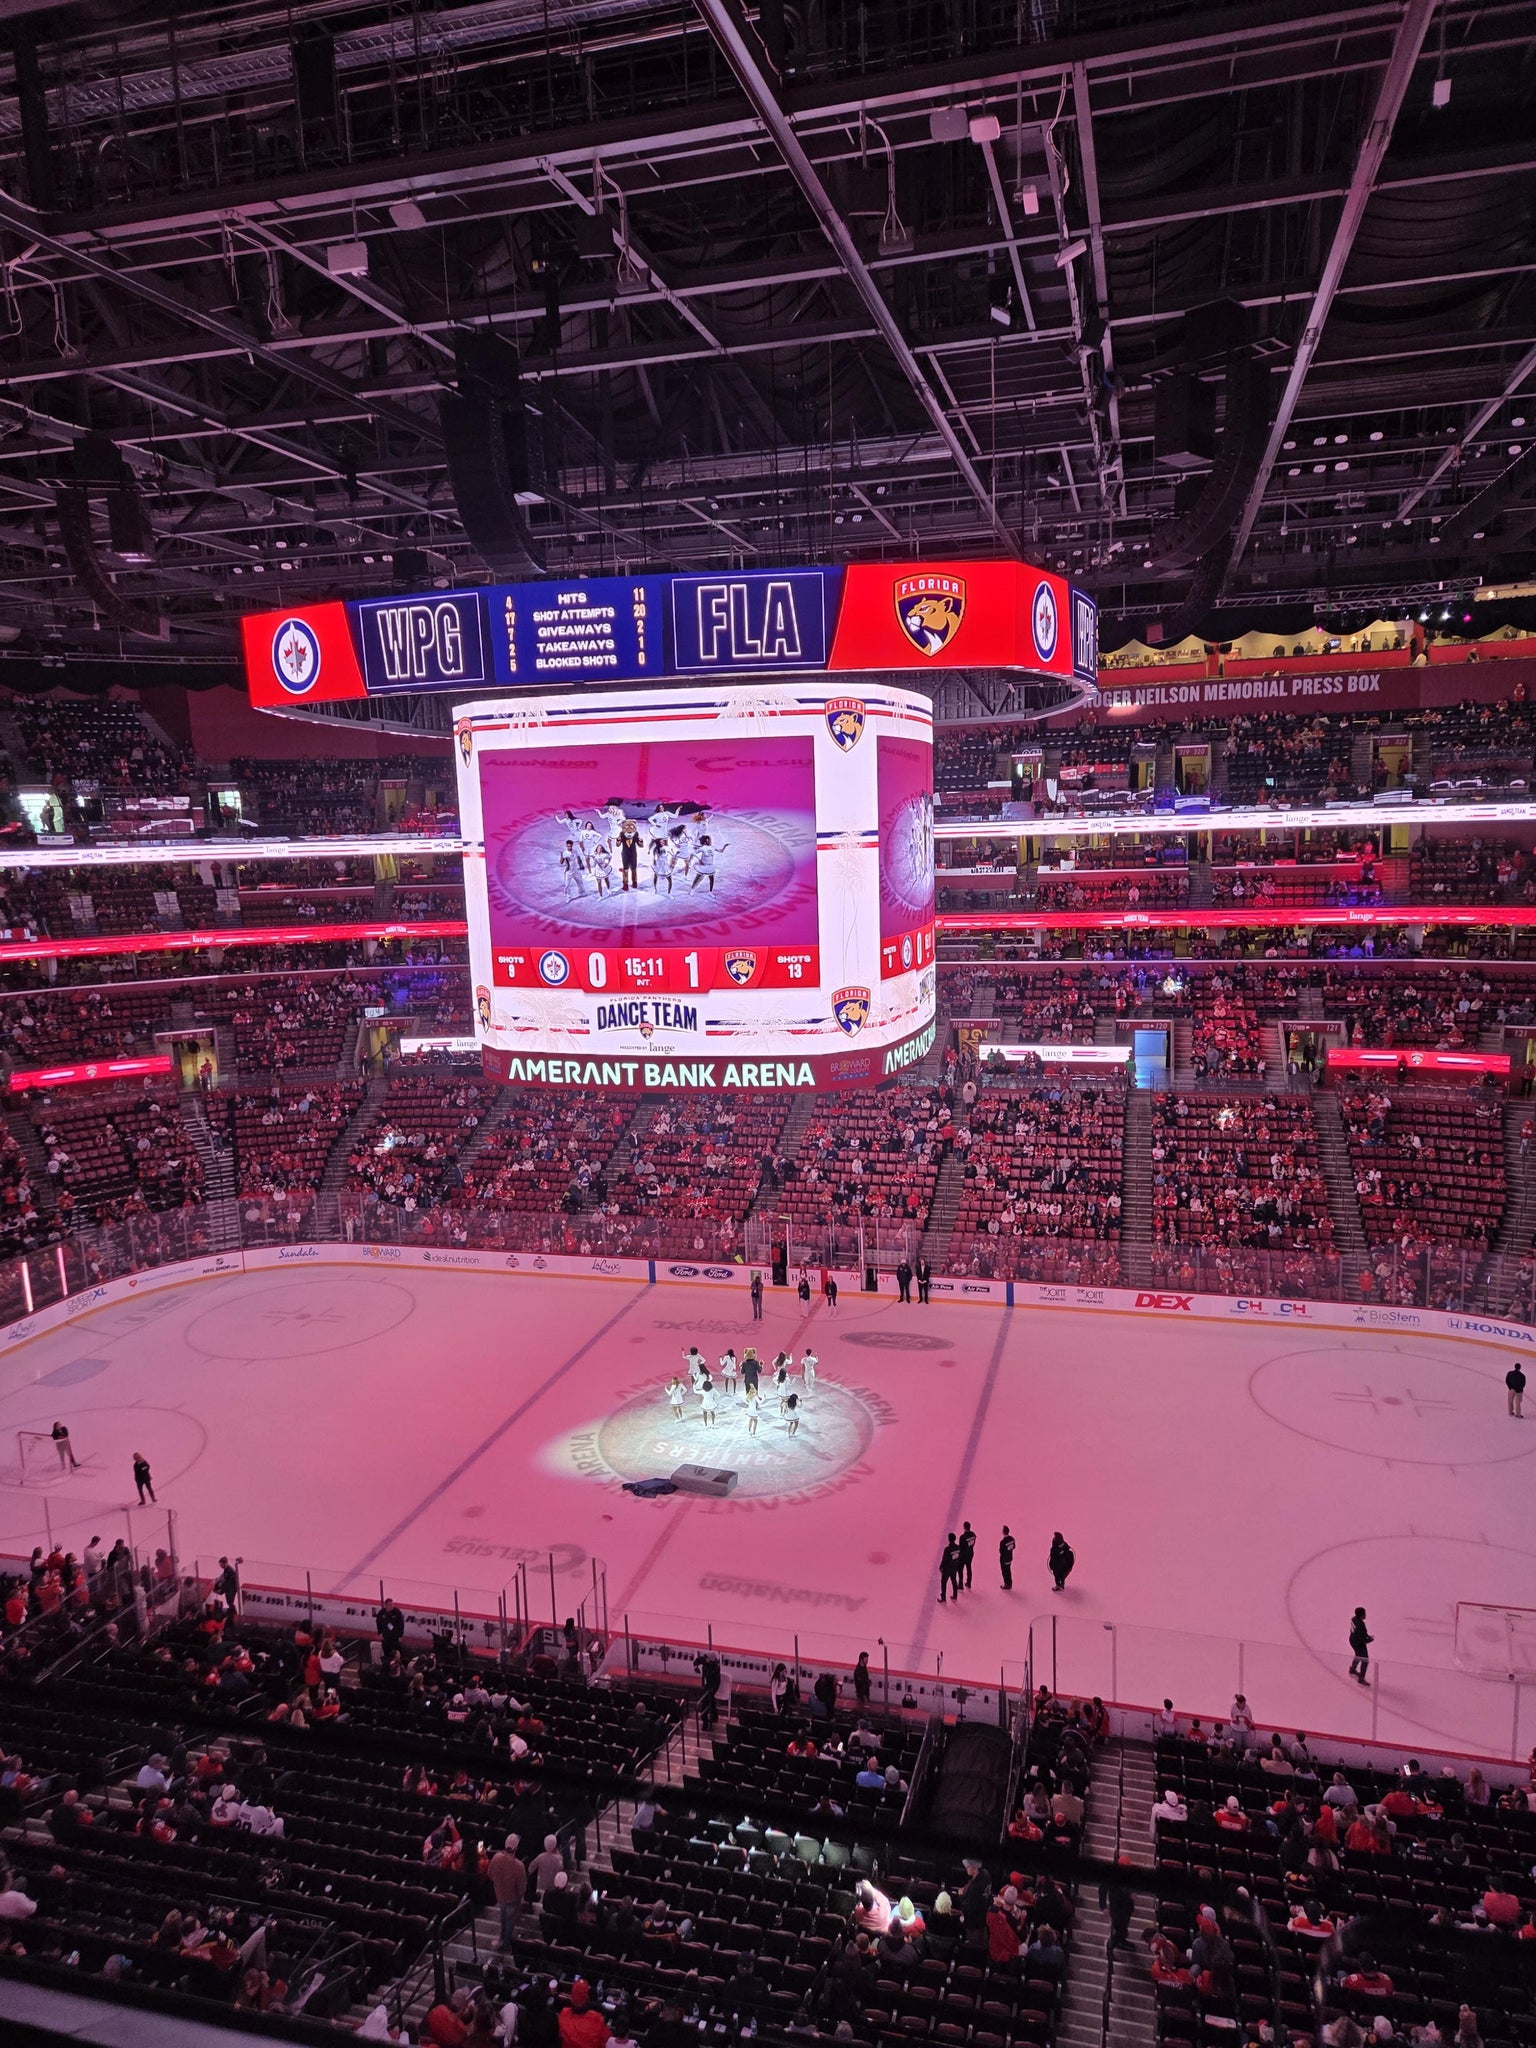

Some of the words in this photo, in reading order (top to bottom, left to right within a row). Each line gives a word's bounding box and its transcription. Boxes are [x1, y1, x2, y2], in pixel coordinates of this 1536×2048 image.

[900, 579, 960, 594] FLORIDA
[557, 592, 588, 605] HITS
[633, 587, 645, 601] 11
[505, 595, 513, 610] 4
[532, 610, 560, 622] SHOT
[561, 607, 615, 621] ATTEMPTS
[633, 603, 646, 618] 20
[504, 611, 516, 626] 17
[697, 582, 801, 660] FLA
[537, 623, 612, 637] GIVEAWAYS
[636, 619, 644, 634] 2
[376, 602, 464, 680] WPG
[507, 627, 514, 641] 7
[536, 639, 615, 653] TAKEAWAYS
[638, 635, 644, 649] 1
[508, 643, 516, 657] 2
[509, 658, 517, 672] 5
[536, 656, 581, 669] BLOCKED
[582, 655, 617, 666] SHOTS
[638, 651, 646, 665] 0
[1135, 685, 1199, 706] NEILSON
[1204, 680, 1288, 701] MEMORIAL
[1292, 677, 1343, 696] PRESS
[1347, 674, 1381, 692] BOX
[828, 699, 864, 711] FLORIDA
[498, 955, 525, 964] SHOTS
[726, 952, 756, 961] FLORIDA
[777, 955, 812, 964] SHOTS
[508, 965, 516, 978] 9
[589, 951, 608, 988] 0
[624, 957, 664, 977] 15:11
[684, 951, 699, 988] 1
[787, 964, 802, 979] 13
[636, 978, 652, 987] INT.
[835, 988, 867, 1001] FLORIDA
[597, 1002, 648, 1030] DANCE
[652, 1002, 698, 1031] TEAM
[509, 1057, 639, 1087] AMERANT
[644, 1063, 716, 1088] BANK
[717, 1063, 815, 1088] ARENA
[278, 1246, 320, 1260] Sandals
[674, 1266, 696, 1277] Ford
[708, 1268, 731, 1280] Ford
[1135, 1292, 1194, 1311] DEX
[1237, 1300, 1262, 1311] CH
[1280, 1303, 1306, 1314] CH
[1370, 1310, 1420, 1323] BioStem
[1464, 1321, 1535, 1342] HONDA
